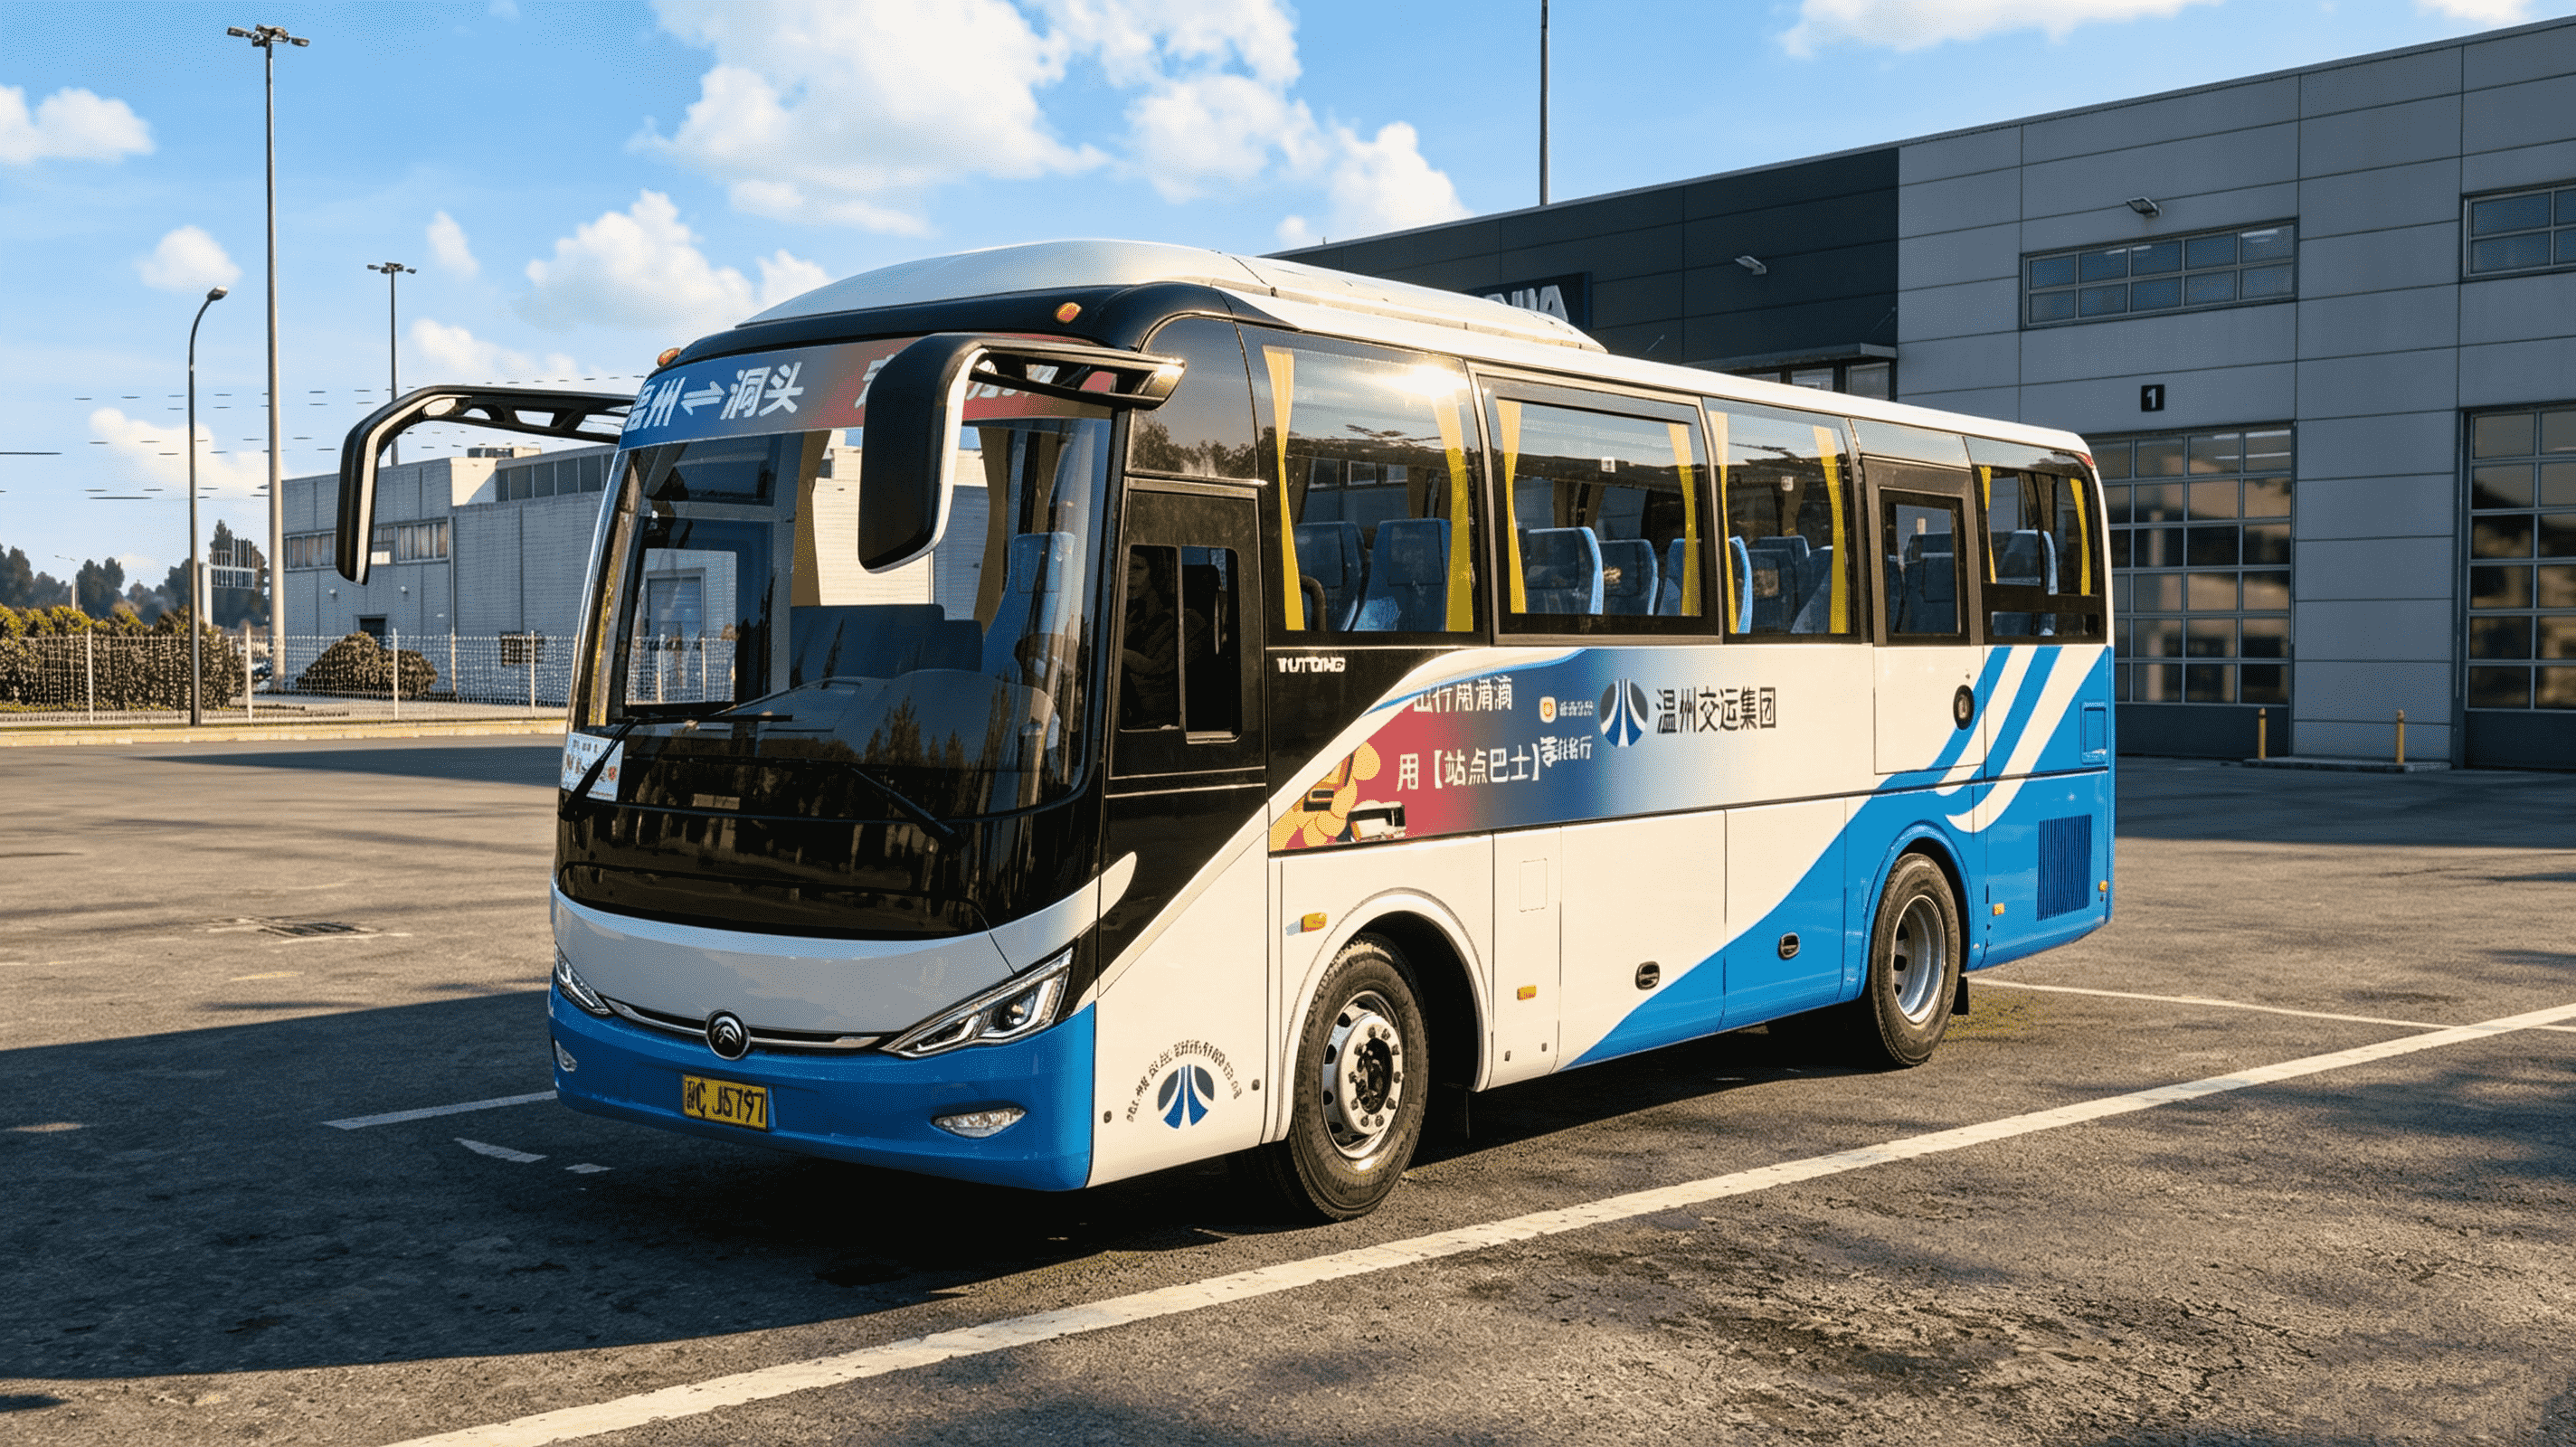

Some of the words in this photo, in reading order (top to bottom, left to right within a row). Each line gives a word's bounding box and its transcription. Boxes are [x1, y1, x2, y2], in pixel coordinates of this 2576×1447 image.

[720, 362, 804, 420] 洞头
[2147, 388, 2156, 408] 1
[1656, 686, 1776, 734] 温州交运集团
